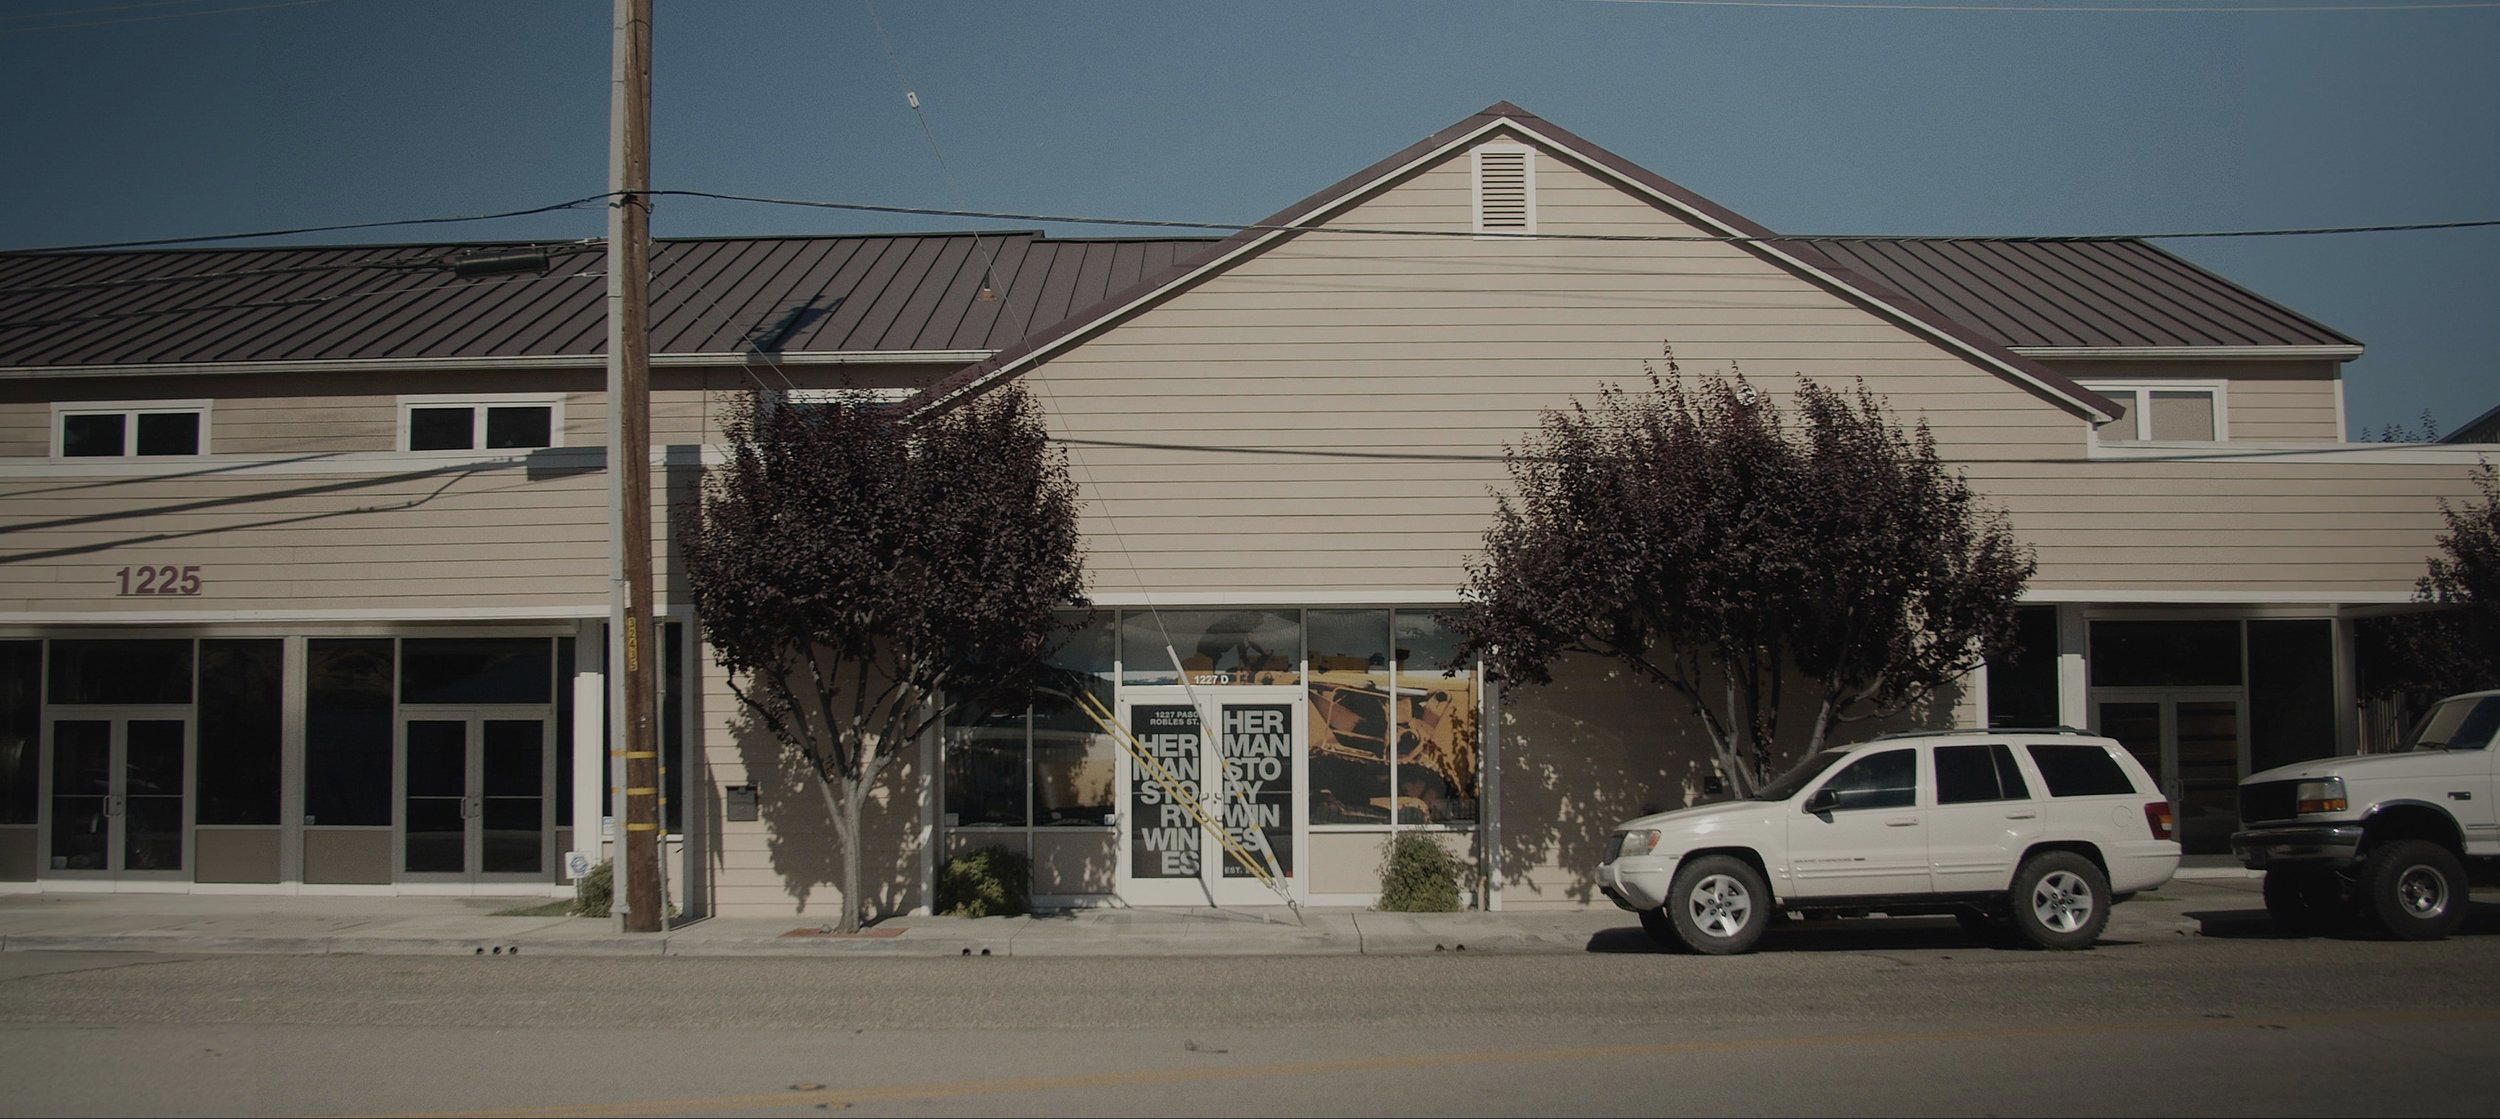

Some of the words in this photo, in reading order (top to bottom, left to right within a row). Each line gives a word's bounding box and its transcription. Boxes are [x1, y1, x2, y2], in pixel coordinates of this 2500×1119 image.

[116, 566, 201, 594] 1225
[1194, 675, 1218, 685] 1227
[1220, 675, 1229, 685] D
[1224, 710, 1284, 734] HER
[1138, 733, 1199, 757] HER
[1224, 734, 1290, 757] MAN
[1133, 757, 1199, 780] MAN
[1223, 757, 1282, 781] STO
[1140, 780, 1200, 805] STO
[1224, 780, 1264, 803] RY
[1161, 804, 1199, 827] RY
[1224, 804, 1279, 827] WIN
[1141, 827, 1199, 851] WIN
[1162, 851, 1200, 875] ES
